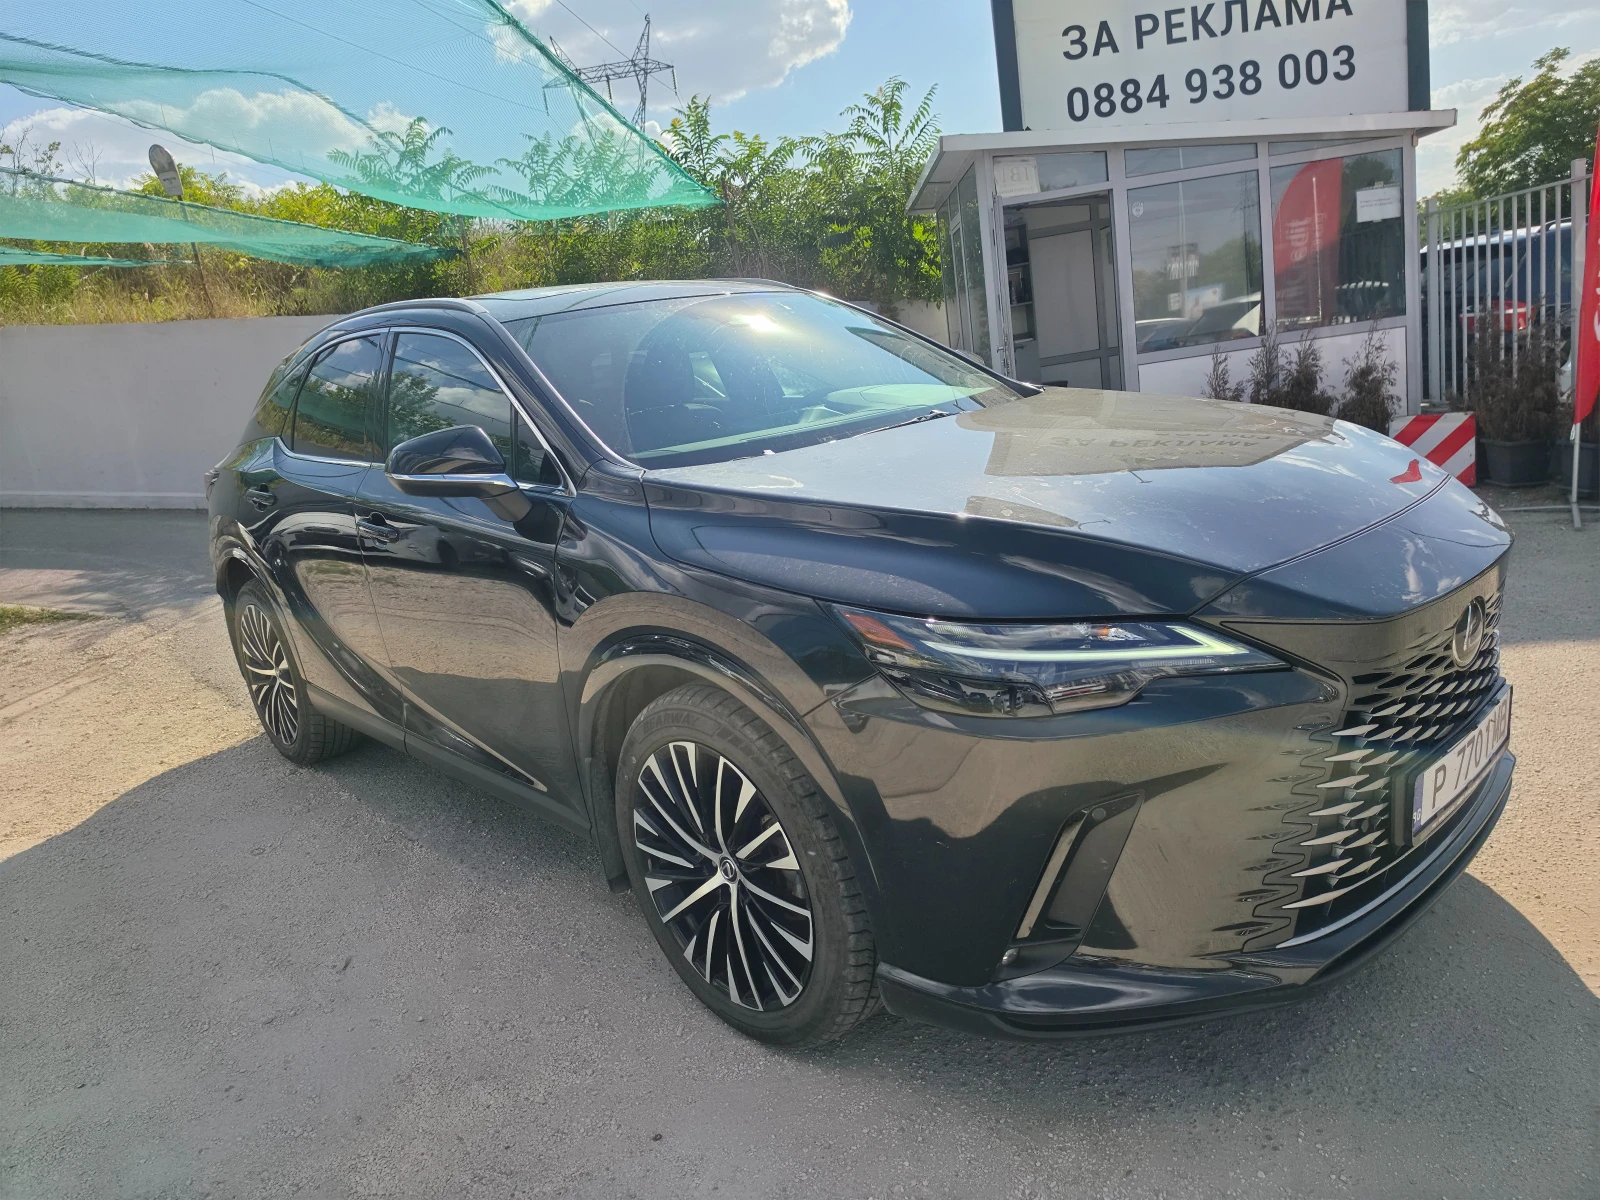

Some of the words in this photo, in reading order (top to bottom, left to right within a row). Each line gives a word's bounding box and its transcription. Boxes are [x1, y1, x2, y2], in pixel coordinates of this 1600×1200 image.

[1061, 20, 1120, 61] ЗА
[1134, 0, 1354, 50] РЕКЛАМА
[1066, 74, 1170, 122] 0884
[1184, 60, 1262, 104] 938
[1278, 45, 1356, 90] 003
[1432, 763, 1447, 810] P
